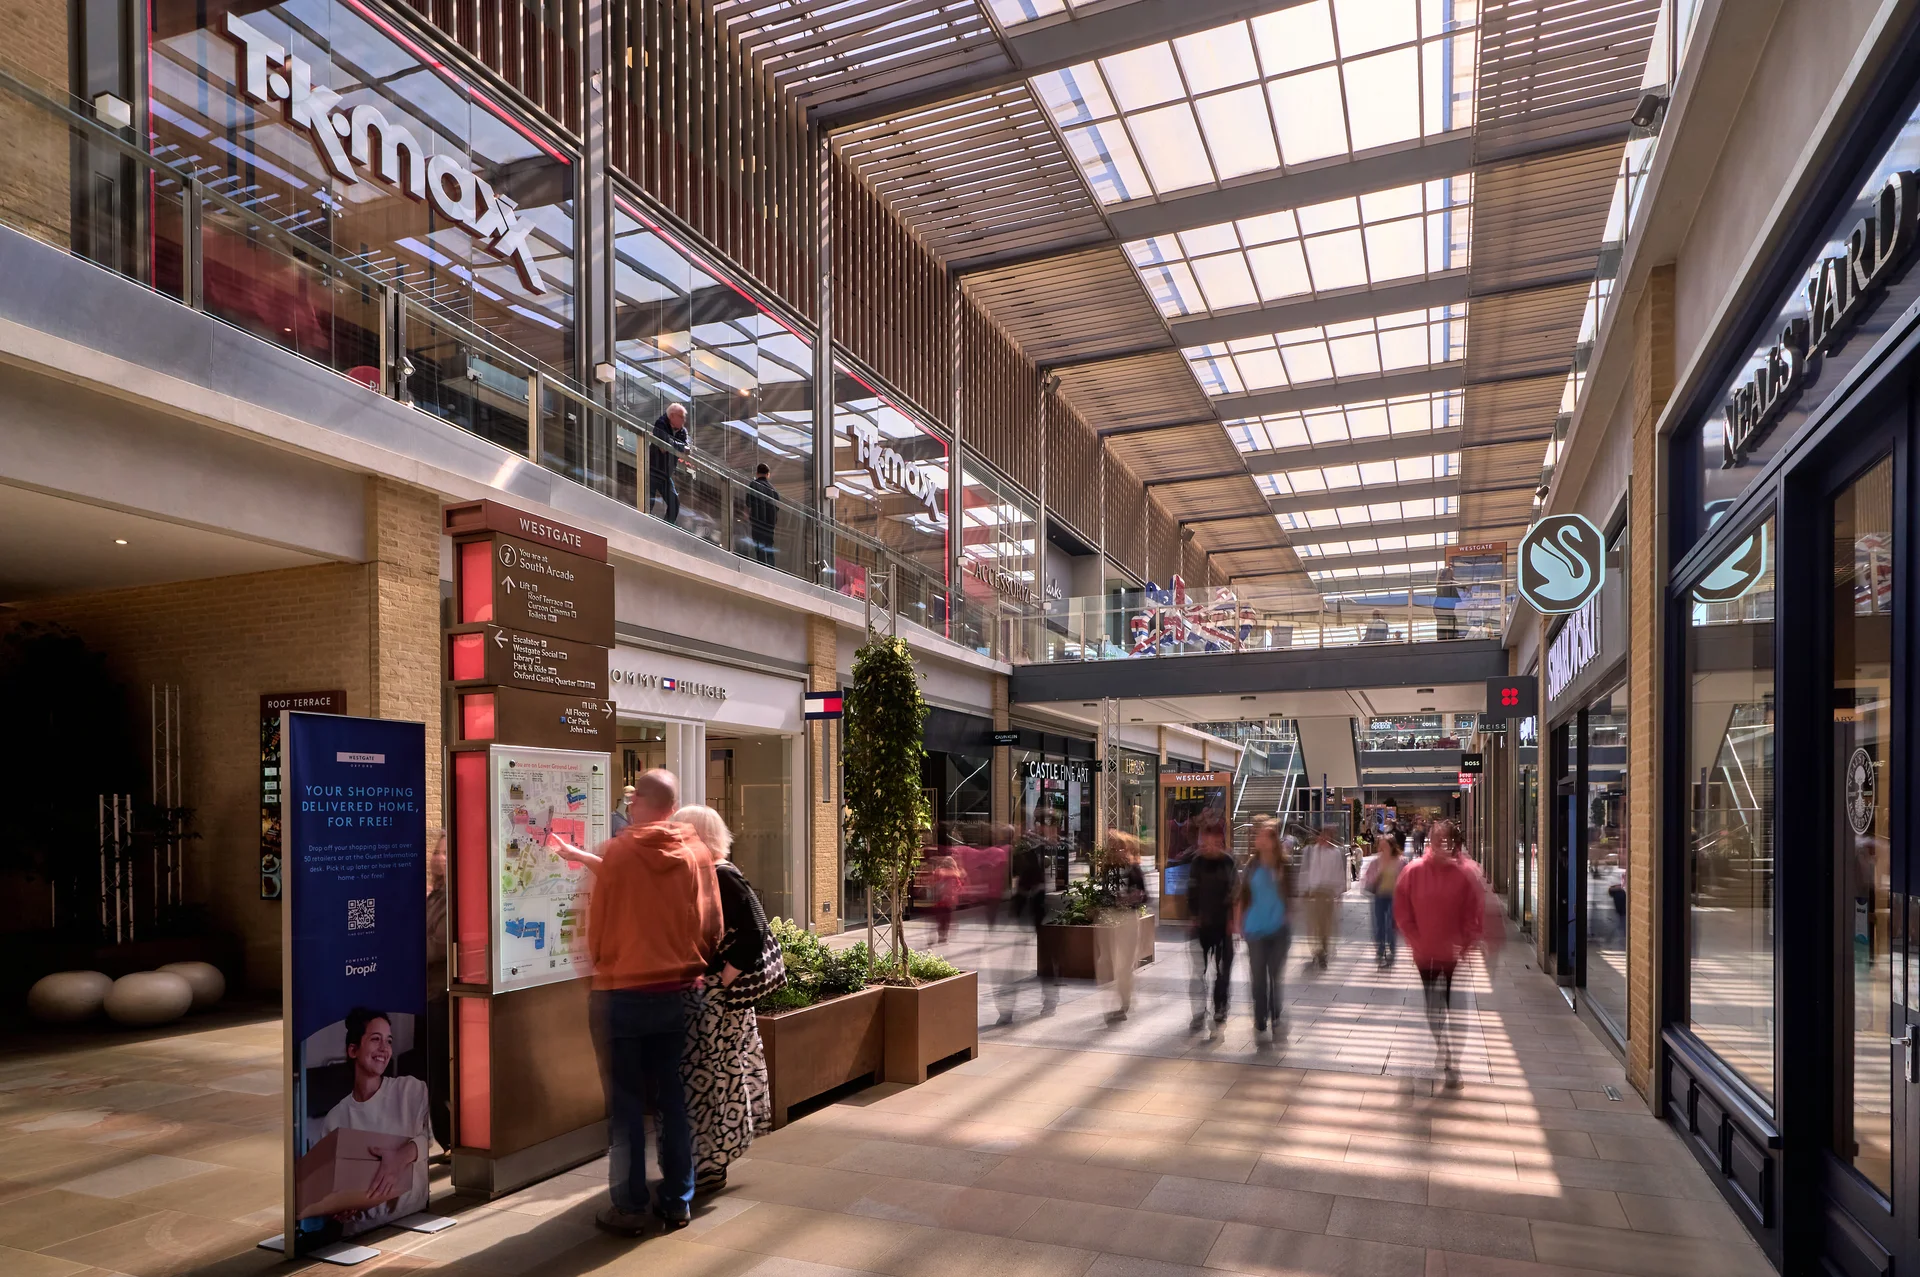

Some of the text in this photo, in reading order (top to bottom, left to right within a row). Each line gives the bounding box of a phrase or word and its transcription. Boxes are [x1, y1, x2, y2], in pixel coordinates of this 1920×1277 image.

[1722, 171, 1903, 469] NEAL'S YARD
[519, 518, 581, 547] WESTGATE
[519, 548, 530, 558] You
[519, 558, 574, 581] South Arcade
[519, 581, 531, 591] Lift
[974, 562, 1034, 605] ACCESSORIZE
[527, 591, 564, 607] Roof Terrace
[527, 601, 571, 617] Curzon Cinema
[527, 609, 547, 620] Toilets
[512, 634, 540, 646] Escalator
[513, 643, 558, 659] Westgate Social
[513, 653, 534, 664] Library
[513, 661, 527, 671] Park
[533, 665, 547, 674] Ride
[513, 670, 577, 687] Oxford Castle Quarter
[611, 668, 728, 700] OMMY HILFIGER
[267, 697, 331, 709] ROOF TERRACE
[588, 702, 598, 711] Lift
[573, 708, 590, 718] Floors
[567, 716, 590, 726] Car Park
[569, 725, 598, 735] John Lewis
[1029, 760, 1059, 780] CASTLE
[1060, 764, 1075, 782] FINE
[1076, 767, 1089, 783] ART
[1175, 774, 1215, 782] WESTGATE
[305, 785, 413, 797] YOUR SHOPPING
[301, 801, 419, 813] DELIVERED HOME,
[327, 816, 393, 827] FOR FREE!
[308, 845, 322, 853] Drop
[334, 845, 348, 853] your
[348, 843, 377, 852] shopping
[311, 854, 337, 862] retailers
[326, 864, 339, 872] Pick
[345, 962, 377, 976] Dropit
